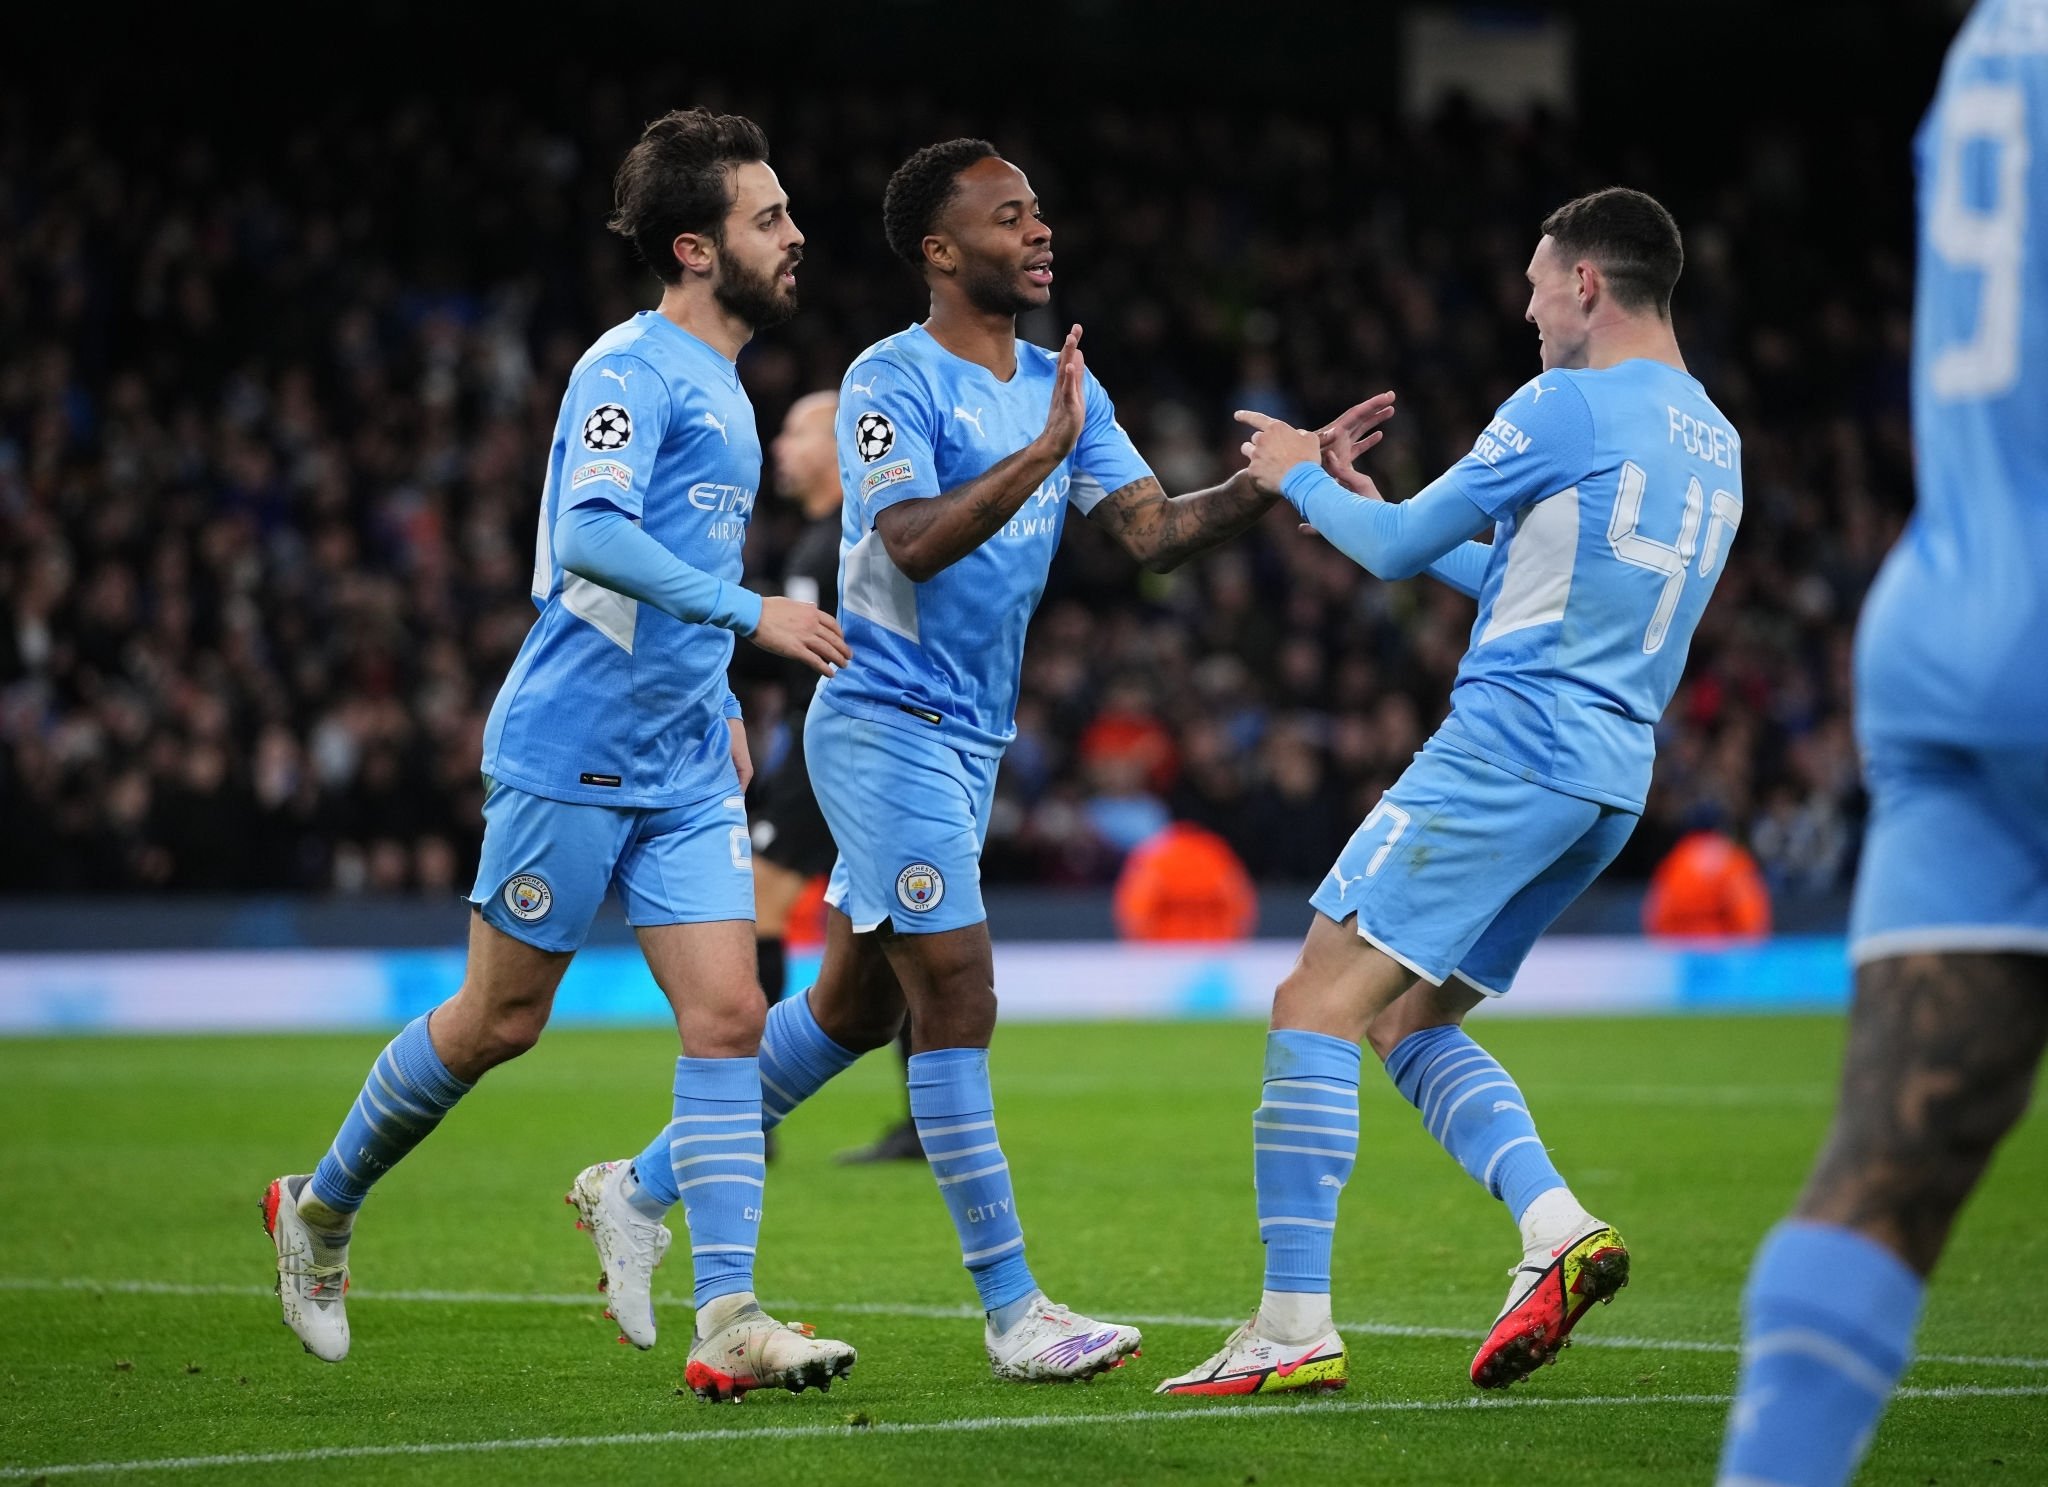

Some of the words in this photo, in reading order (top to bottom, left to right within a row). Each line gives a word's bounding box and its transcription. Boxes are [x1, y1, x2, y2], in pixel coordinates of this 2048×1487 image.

[1932, 84, 2030, 398] 9
[1667, 405, 1739, 472] FODEN
[574, 465, 632, 483] FOUNDATION
[687, 482, 756, 515] ETIHA
[1361, 801, 1411, 877] 7
[900, 865, 939, 884] MANCHESTER
[512, 877, 550, 900] MANCHESTER
[513, 908, 528, 919] CITY
[967, 1197, 1010, 1223] CITY
